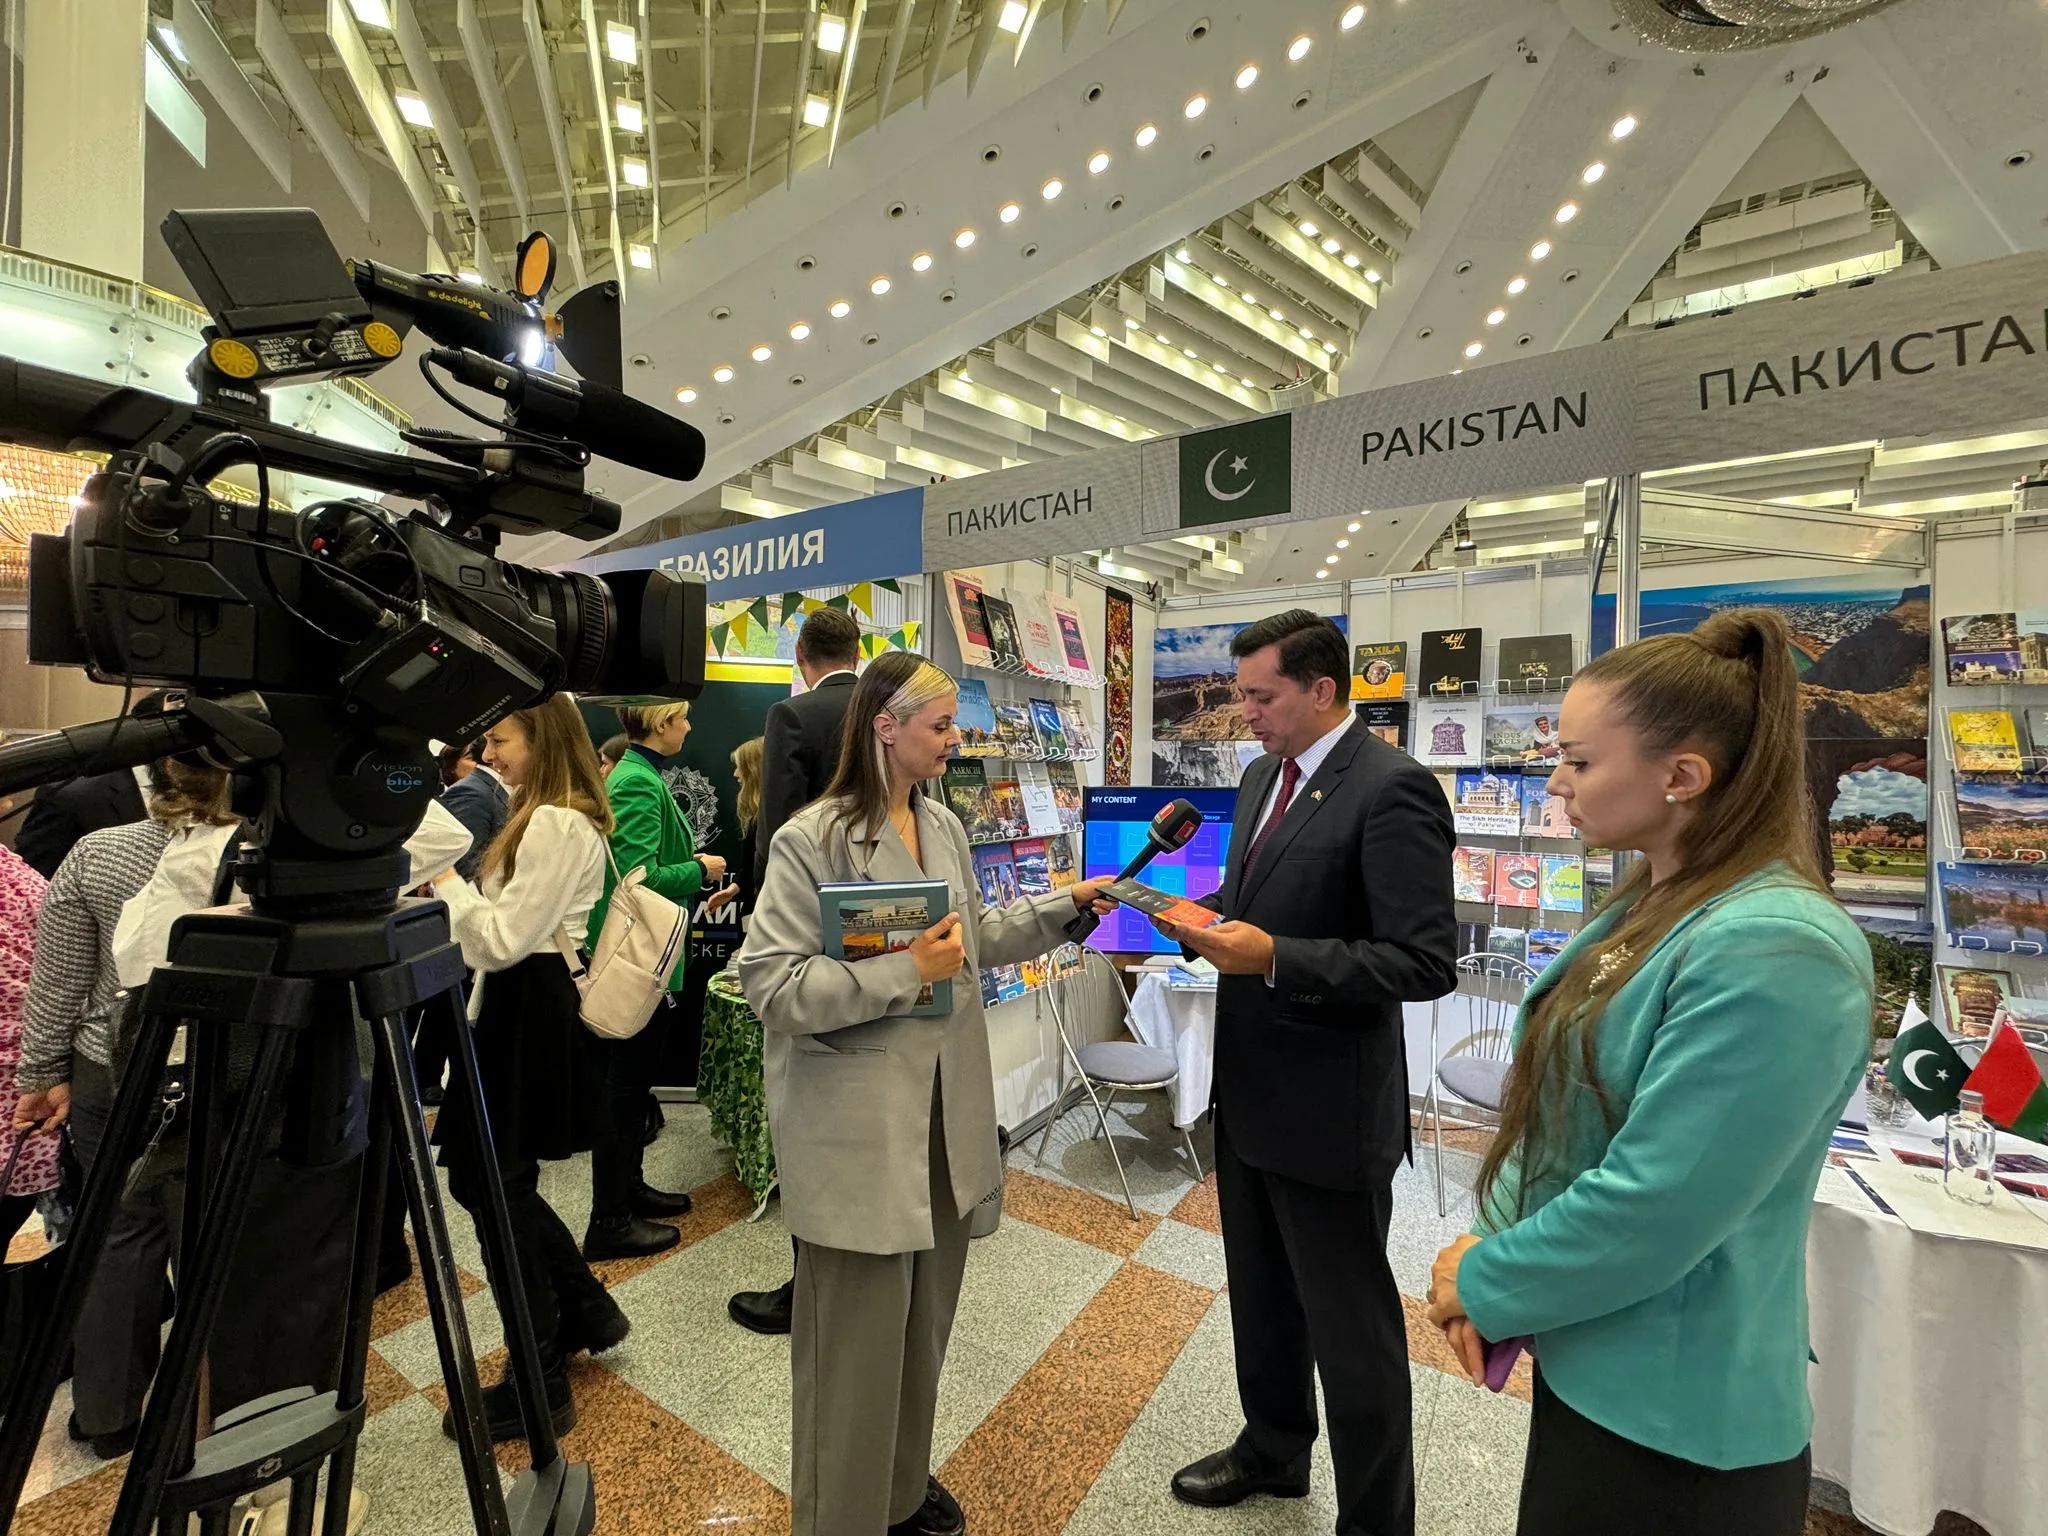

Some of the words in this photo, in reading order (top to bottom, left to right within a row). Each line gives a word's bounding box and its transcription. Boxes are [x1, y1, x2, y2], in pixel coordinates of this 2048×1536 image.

[438, 292, 483, 310] dedolight
[1699, 307, 2048, 411] ПАКИСТА
[1361, 391, 1587, 465] PAKISTAN
[947, 486, 1092, 536] ПАКИСТАН
[1359, 644, 1402, 656] TAXILA
[952, 766, 981, 775] KARACHI
[386, 777, 423, 786] blue
[1091, 796, 1103, 804] MY
[1104, 796, 1137, 804] CONTENT
[1489, 938, 1523, 949] PAKISTAN
